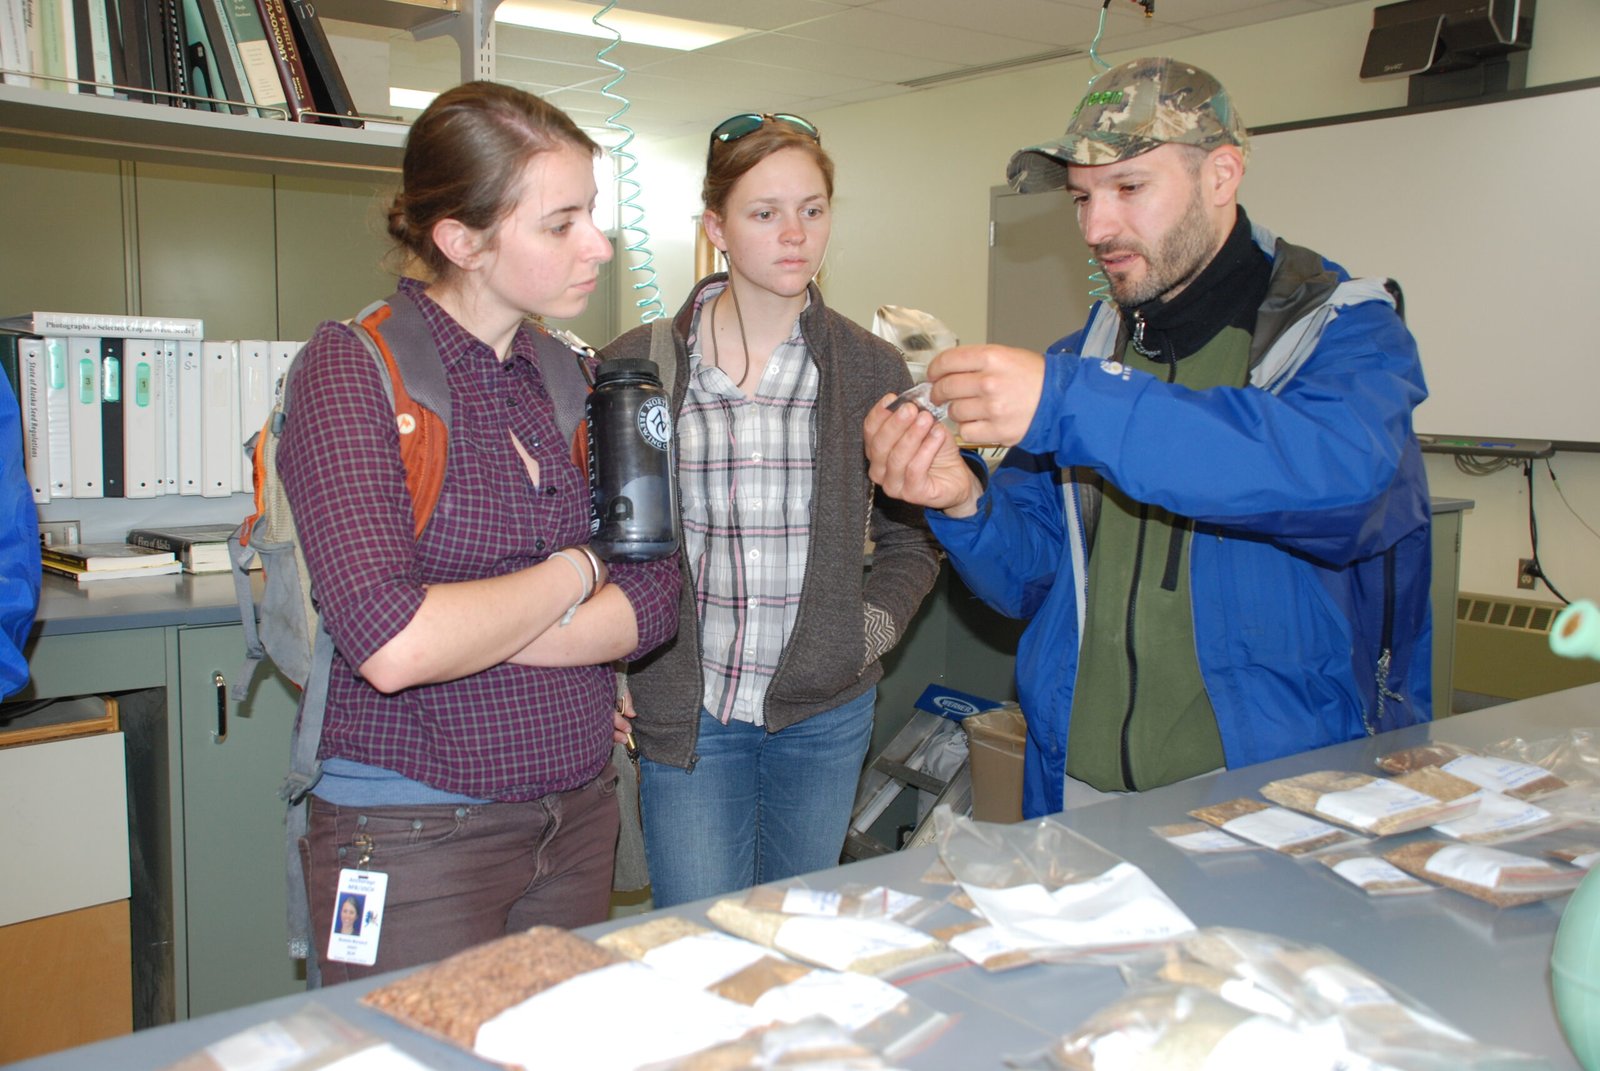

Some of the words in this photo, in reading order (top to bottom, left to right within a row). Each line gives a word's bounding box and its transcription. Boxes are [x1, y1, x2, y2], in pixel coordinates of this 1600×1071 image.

[280, 17, 297, 61] PURITY
[46, 321, 90, 331] Photographs
[29, 422, 38, 458] Regulations
[640, 411, 662, 448] BREWING
[941, 699, 973, 713] WERNER
